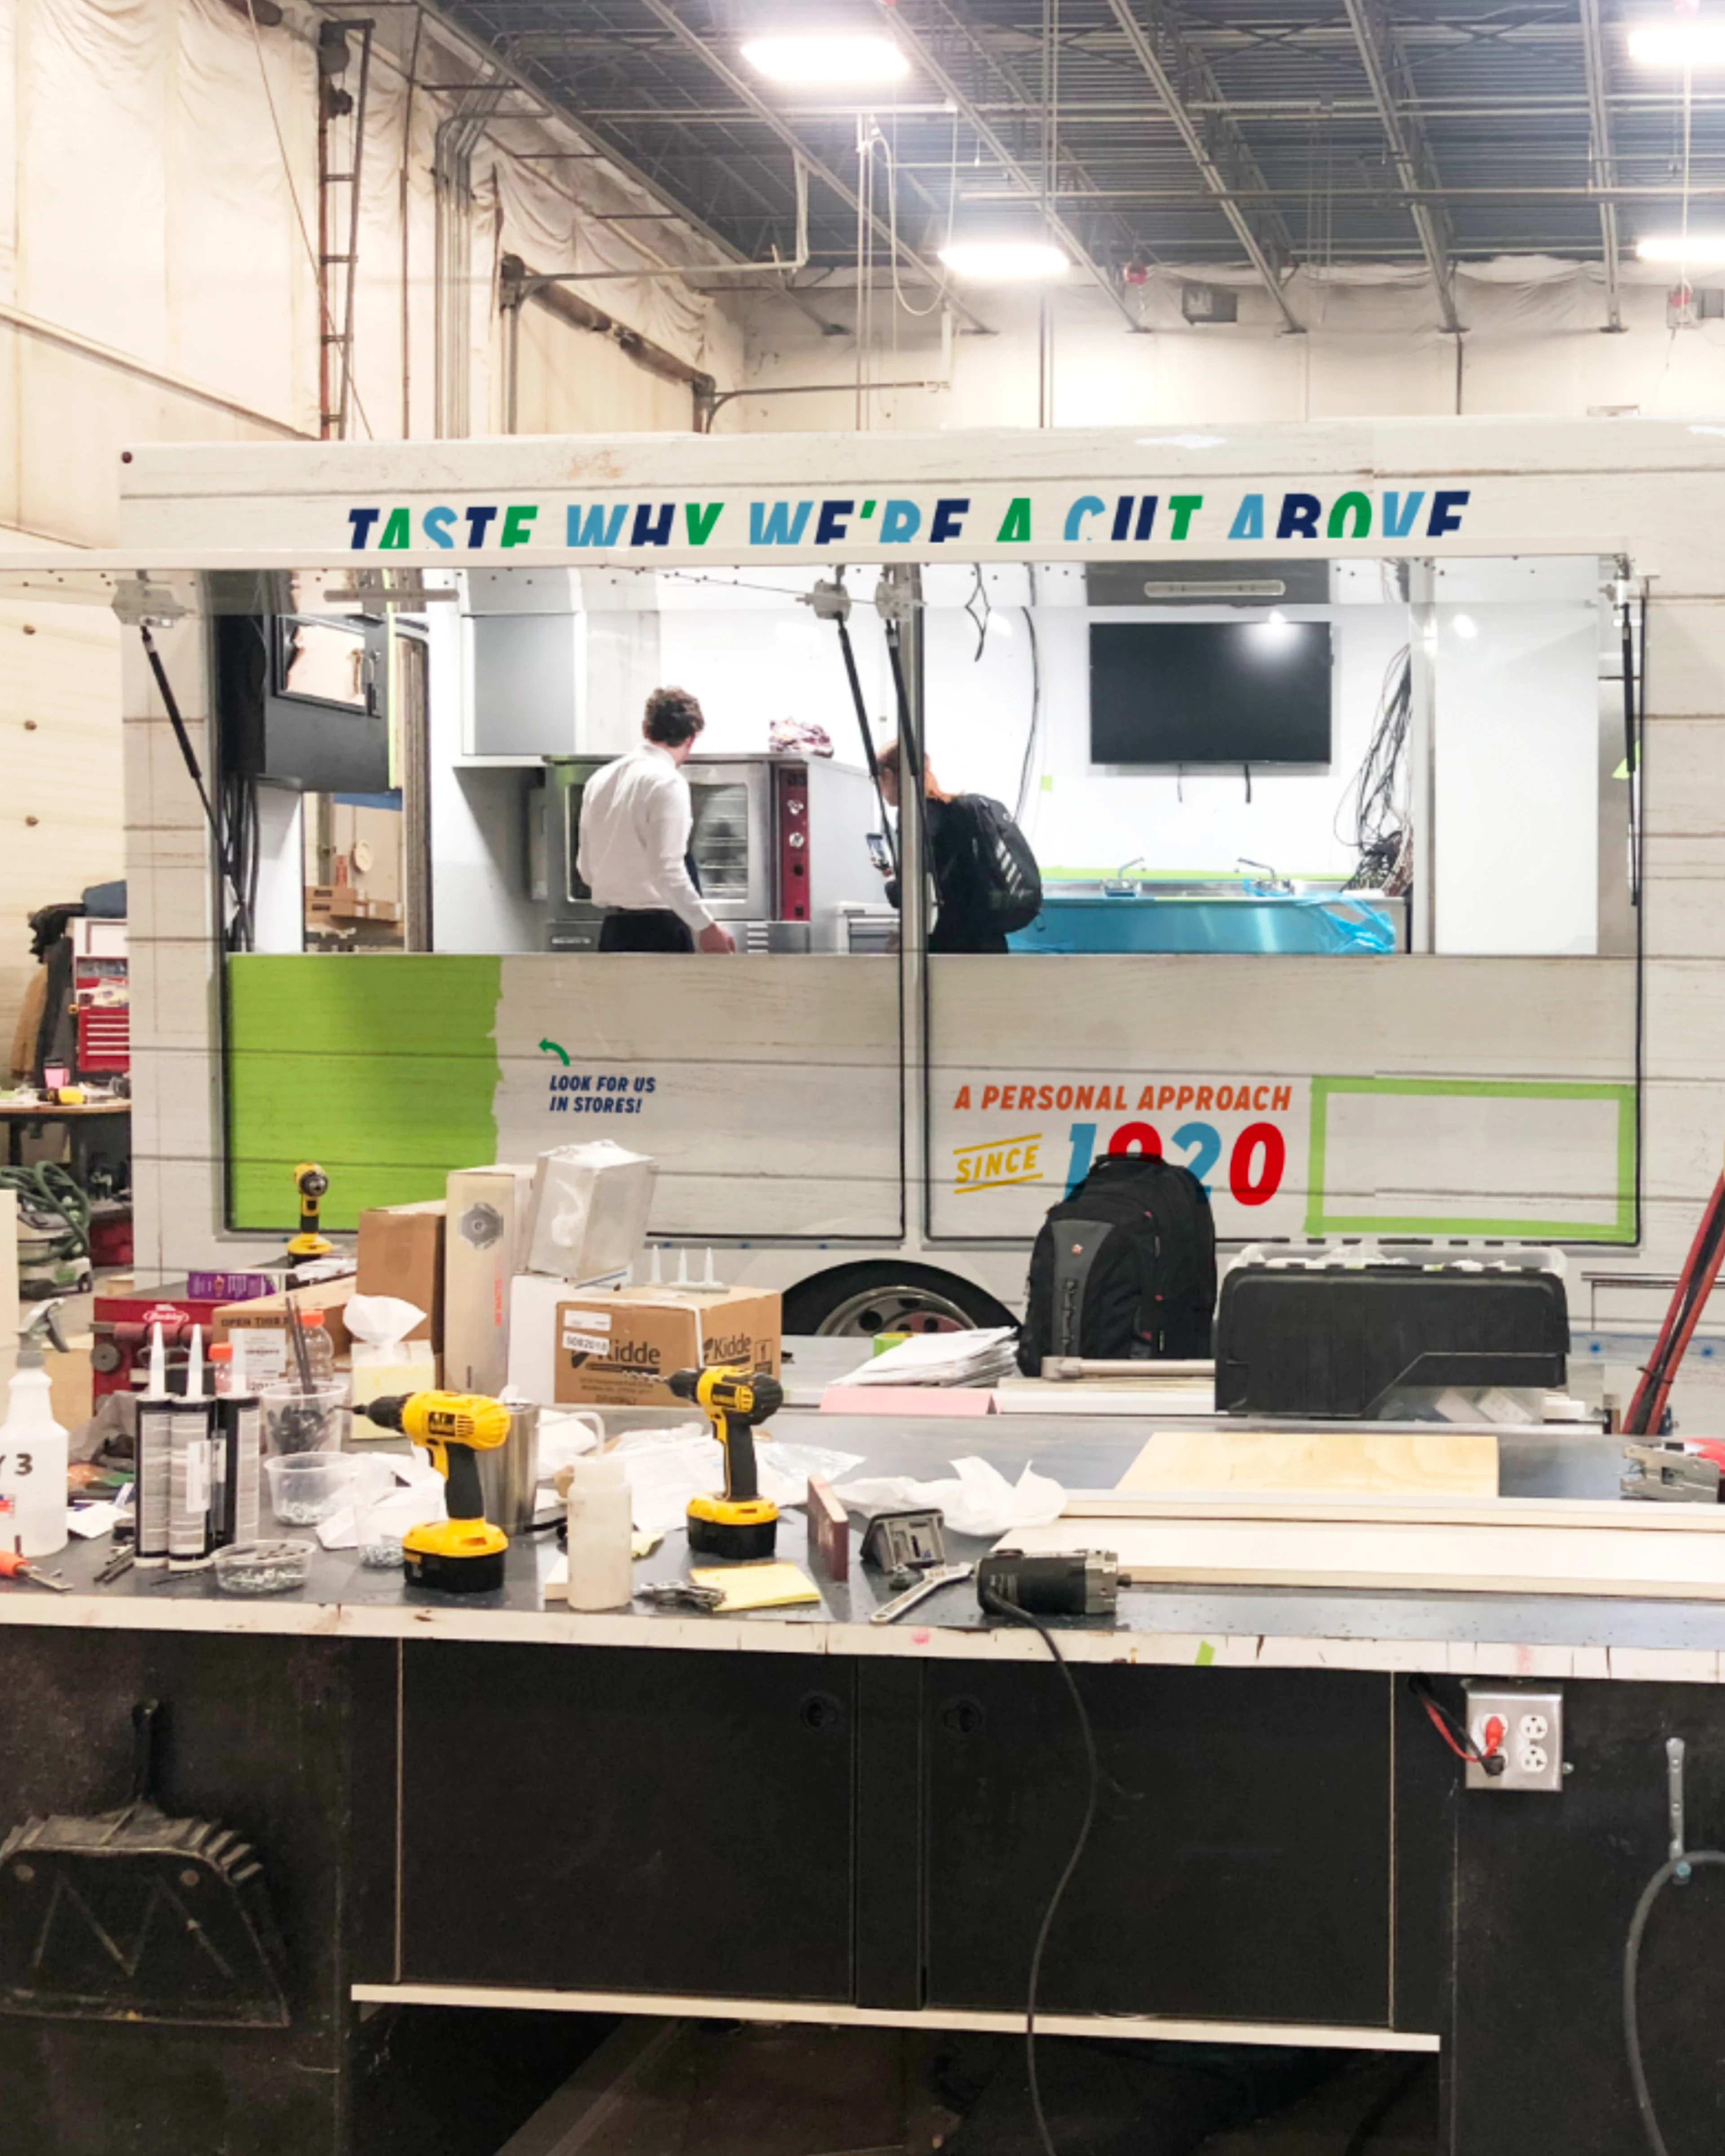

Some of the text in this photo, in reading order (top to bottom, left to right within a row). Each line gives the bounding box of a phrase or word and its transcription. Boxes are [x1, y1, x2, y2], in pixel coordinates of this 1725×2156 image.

[996, 498, 1031, 542] A
[549, 1075, 656, 1093] LOOK FOR US
[549, 1096, 642, 1113] IN STORES!
[953, 1085, 1292, 1111] A PERSONAL APPROACH
[955, 1144, 1040, 1184] SINCE
[714, 1332, 751, 1360] Kidde
[14, 1452, 33, 1476] 3
